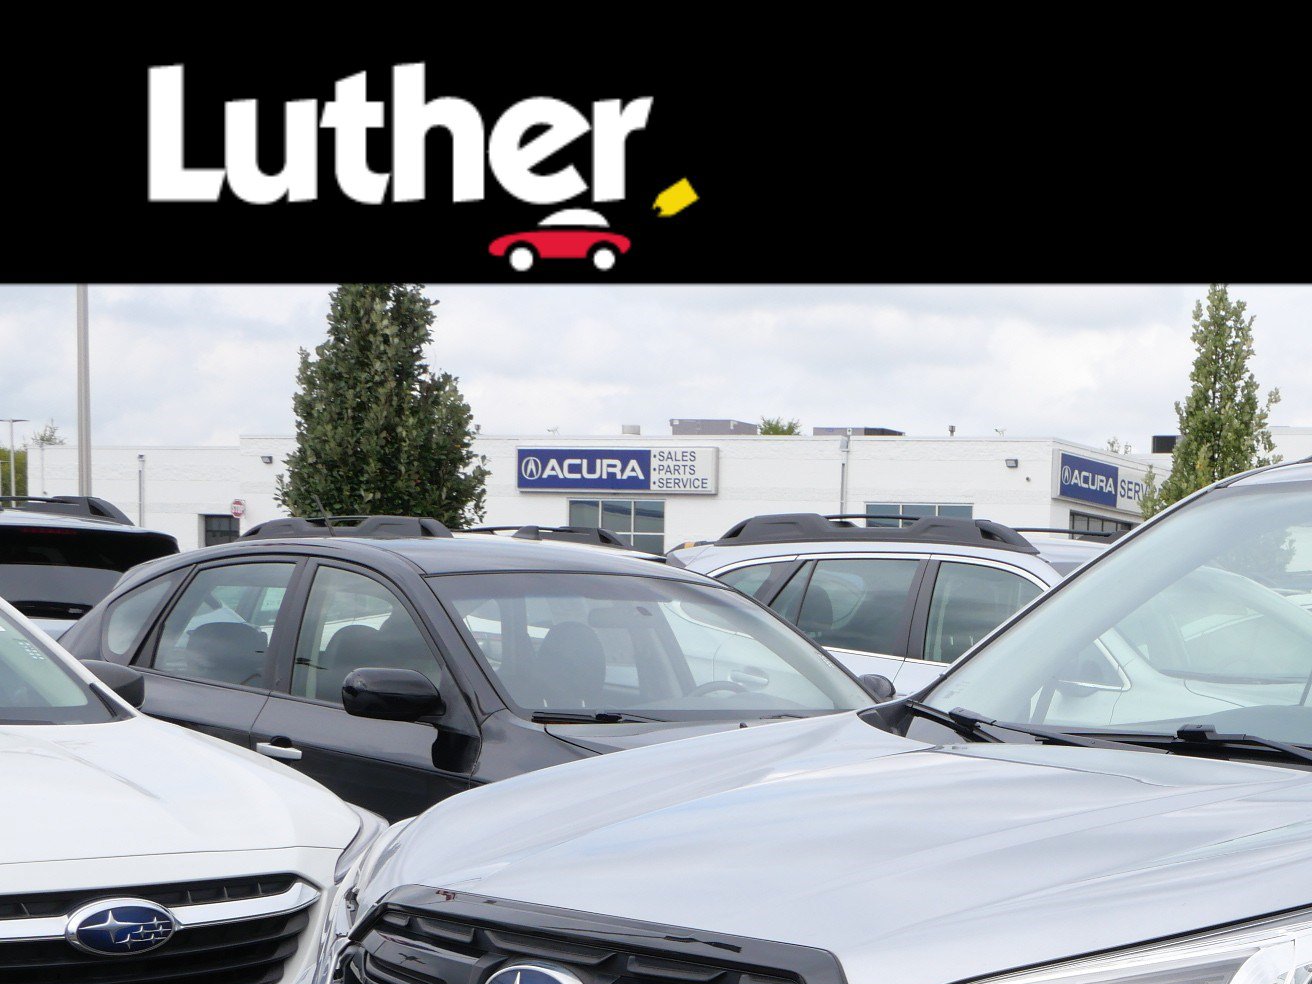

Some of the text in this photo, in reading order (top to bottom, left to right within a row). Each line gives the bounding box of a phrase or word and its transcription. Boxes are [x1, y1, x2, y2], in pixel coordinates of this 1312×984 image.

[657, 450, 697, 462] SALES
[541, 458, 645, 480] ACURA
[657, 464, 697, 475] PARTS
[657, 477, 709, 489] SERVICE
[1071, 469, 1115, 495] ACURA
